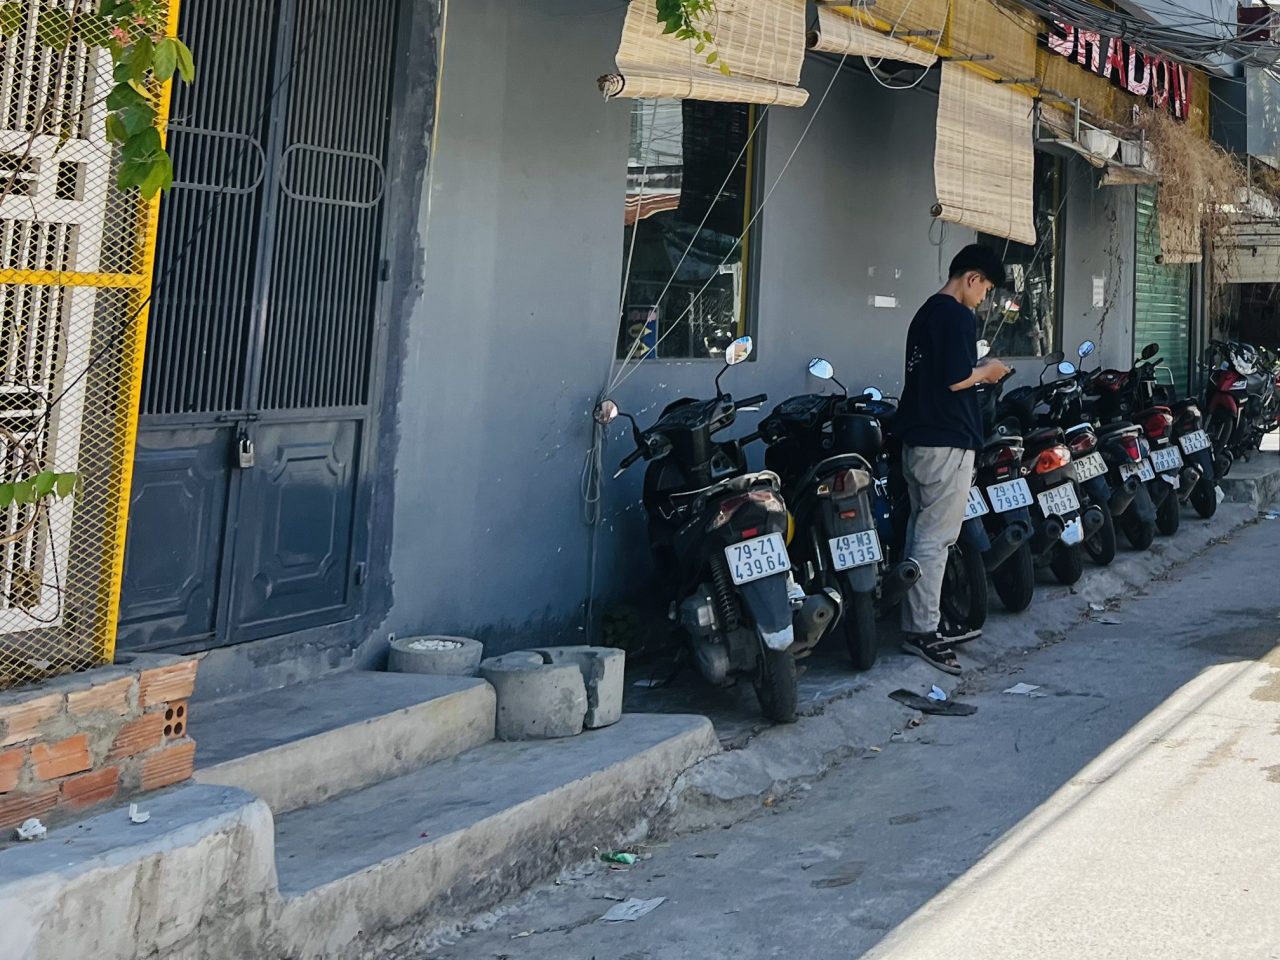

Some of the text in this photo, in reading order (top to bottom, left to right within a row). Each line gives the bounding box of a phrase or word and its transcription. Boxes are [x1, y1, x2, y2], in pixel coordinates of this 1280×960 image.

[997, 493, 1027, 510] 7993
[734, 537, 776, 562] 79-Z1
[838, 546, 876, 567] 9135
[735, 552, 786, 581] 439.64
